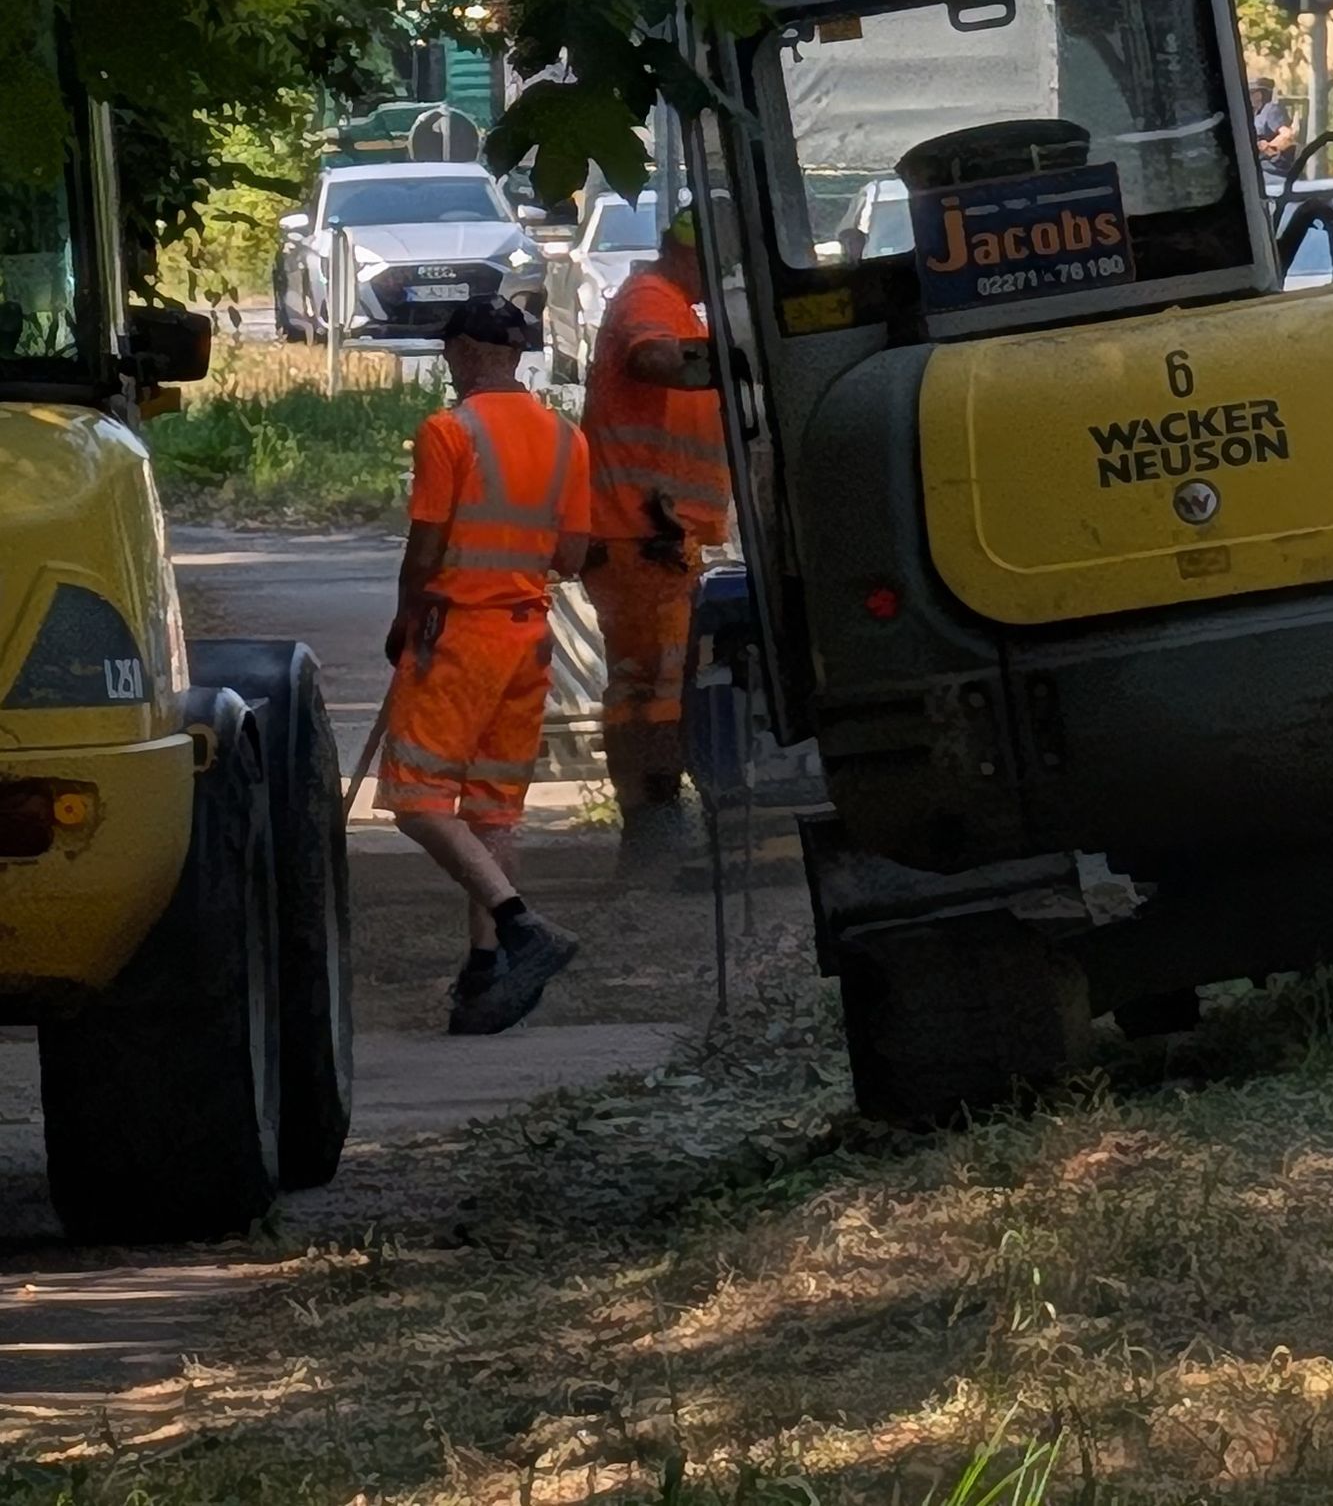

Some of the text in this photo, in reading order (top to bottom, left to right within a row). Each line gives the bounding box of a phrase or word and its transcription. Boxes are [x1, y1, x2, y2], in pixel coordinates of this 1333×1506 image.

[1165, 349, 1195, 399] 6
[1088, 398, 1286, 455] WACKER
[1098, 429, 1290, 488] NEUSON
